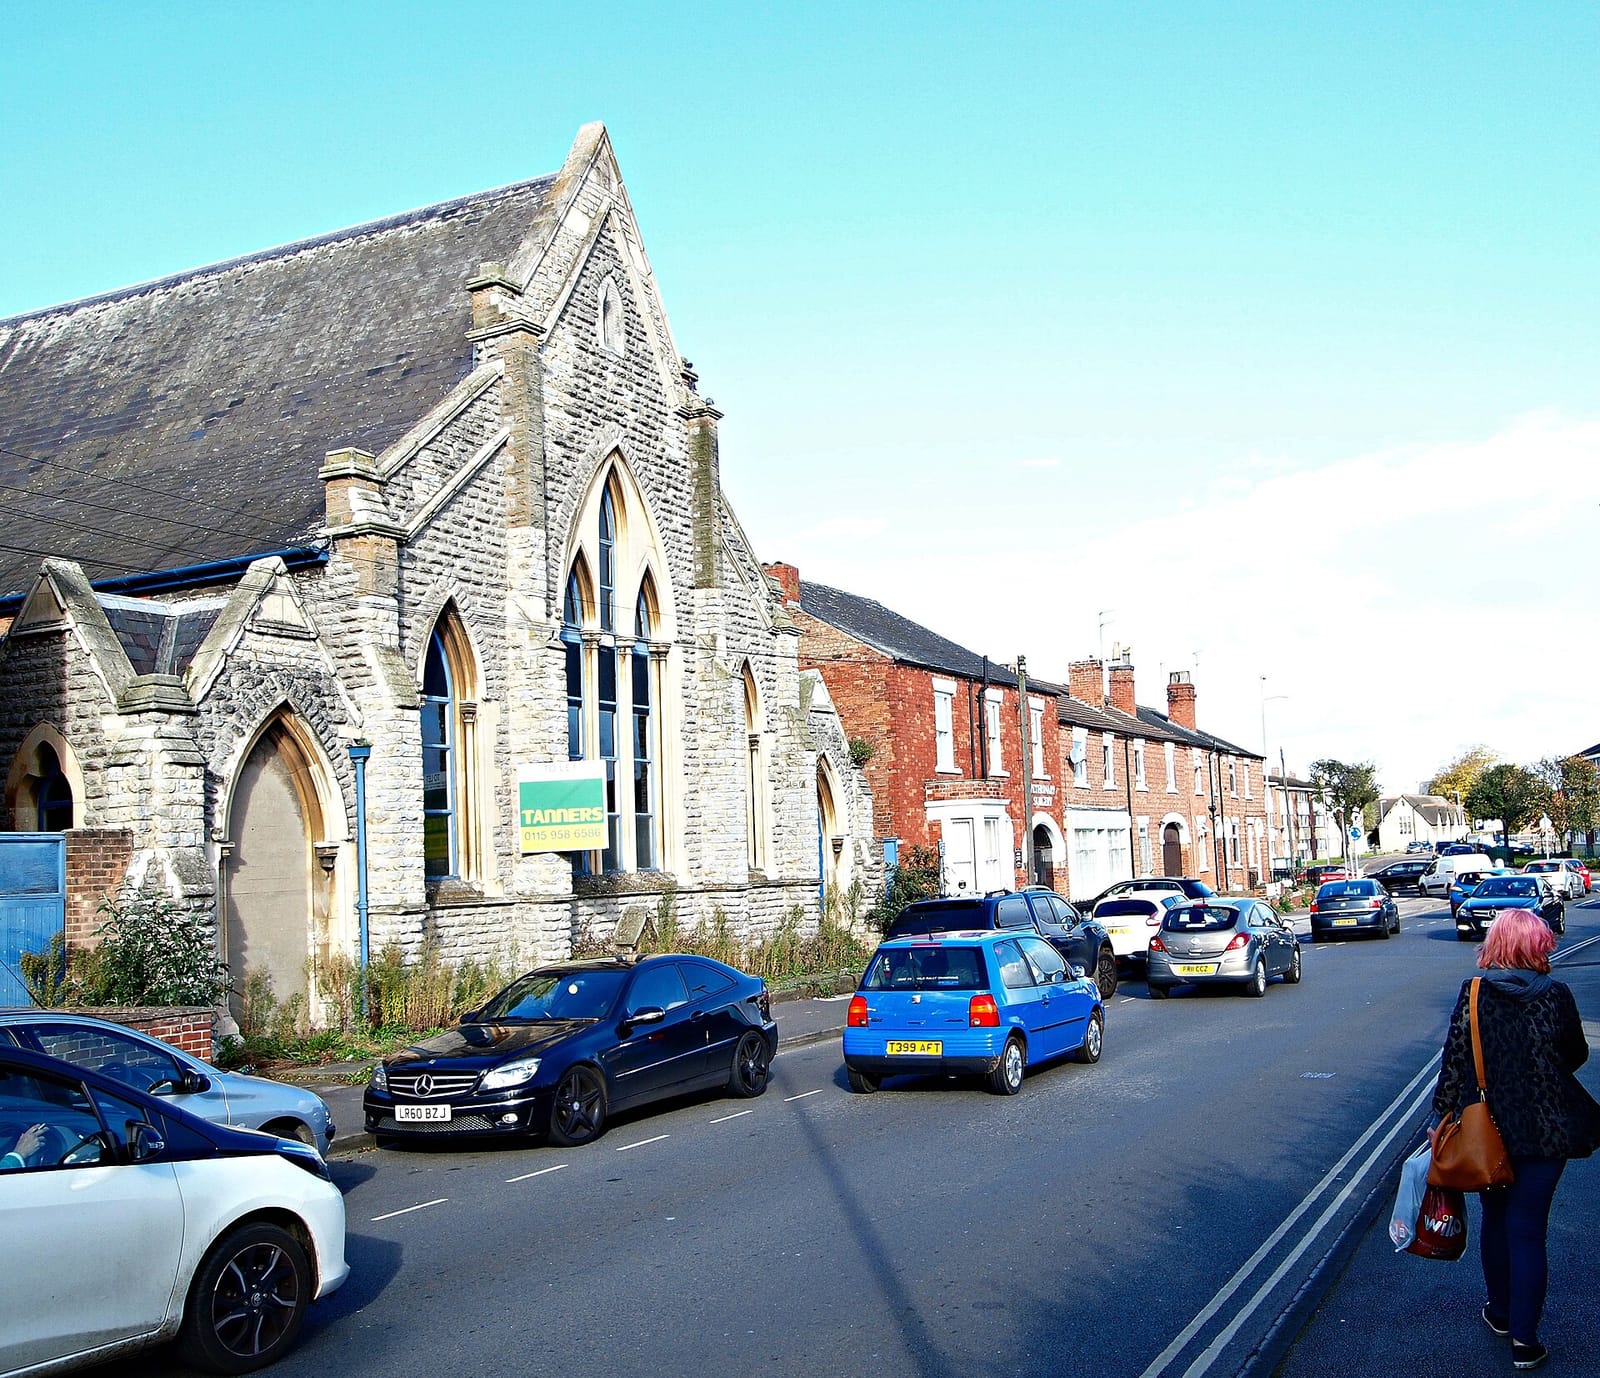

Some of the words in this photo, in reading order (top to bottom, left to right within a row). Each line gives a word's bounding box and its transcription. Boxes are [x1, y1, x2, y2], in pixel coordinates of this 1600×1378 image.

[521, 807, 603, 825] TANNERS
[524, 831, 547, 841] 0115
[551, 830, 570, 839] 958
[574, 828, 601, 838] 6586
[889, 1042, 917, 1053] T399
[919, 1042, 941, 1053] AFT
[399, 1107, 423, 1119] LR60
[425, 1107, 446, 1119] BZJ
